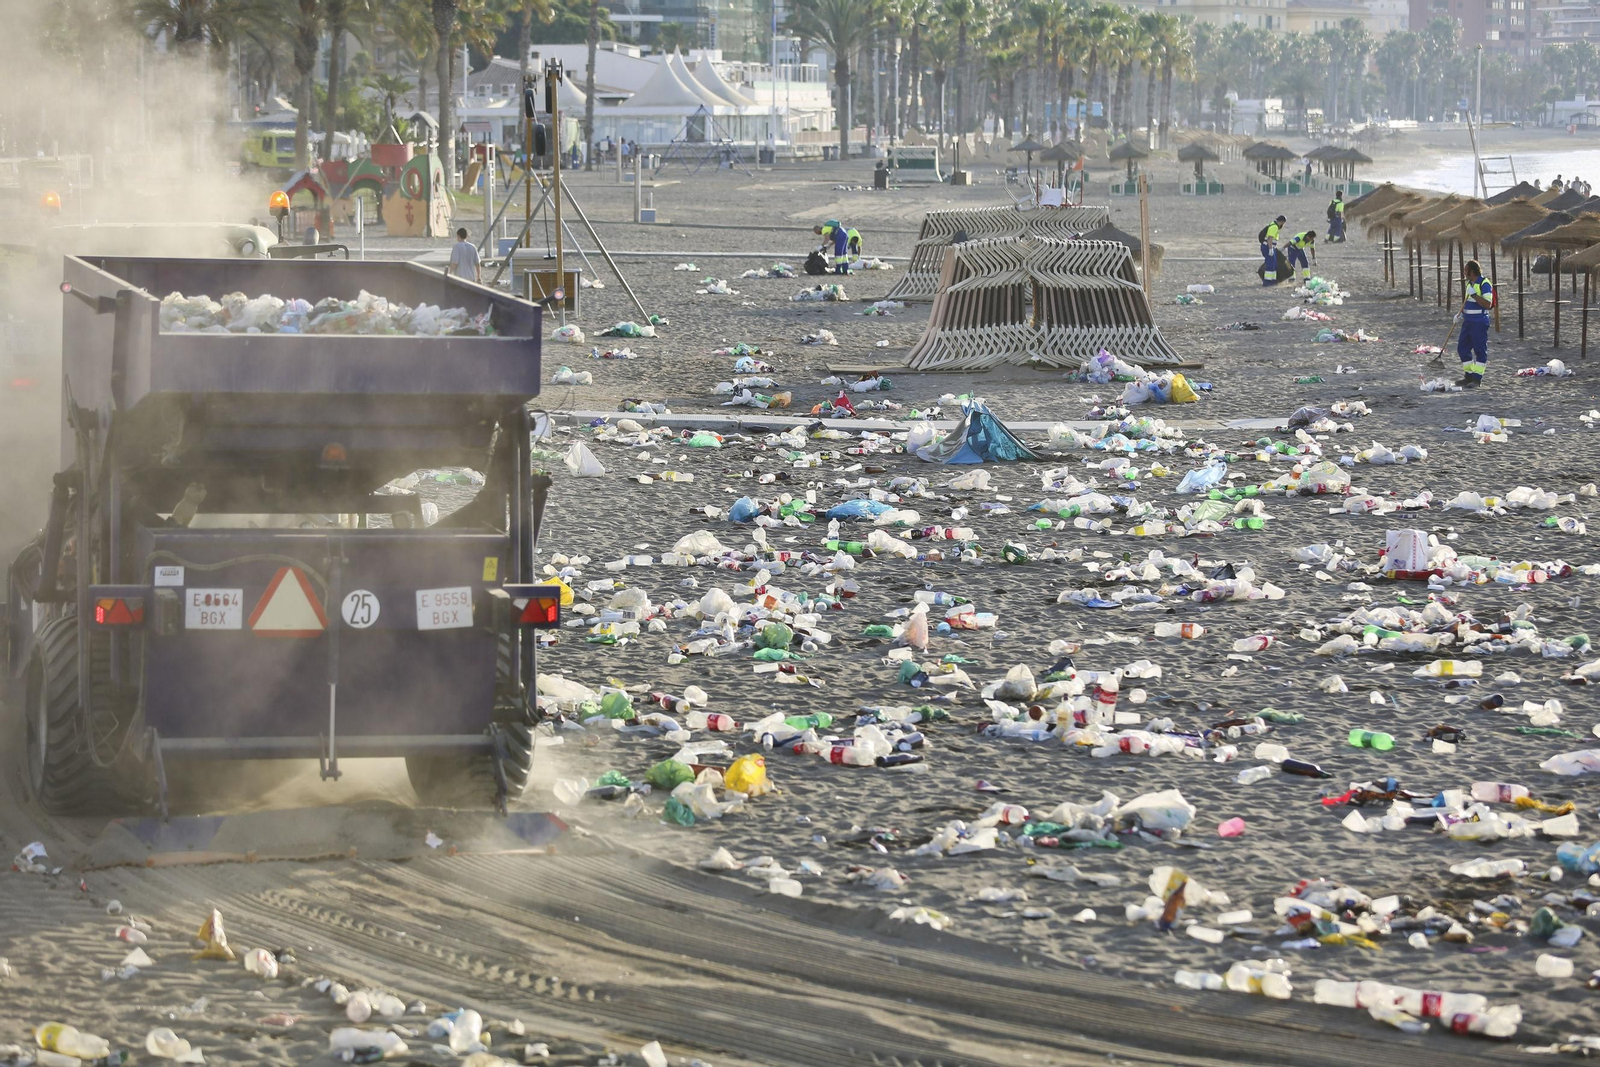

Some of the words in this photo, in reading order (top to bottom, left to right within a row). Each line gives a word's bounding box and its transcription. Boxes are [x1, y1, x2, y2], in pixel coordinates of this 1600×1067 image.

[193, 593, 201, 607] E
[421, 594, 429, 608] E
[434, 592, 468, 607] 9559
[350, 594, 372, 625] 25
[201, 611, 227, 625] BGX
[432, 610, 459, 625] BGX
